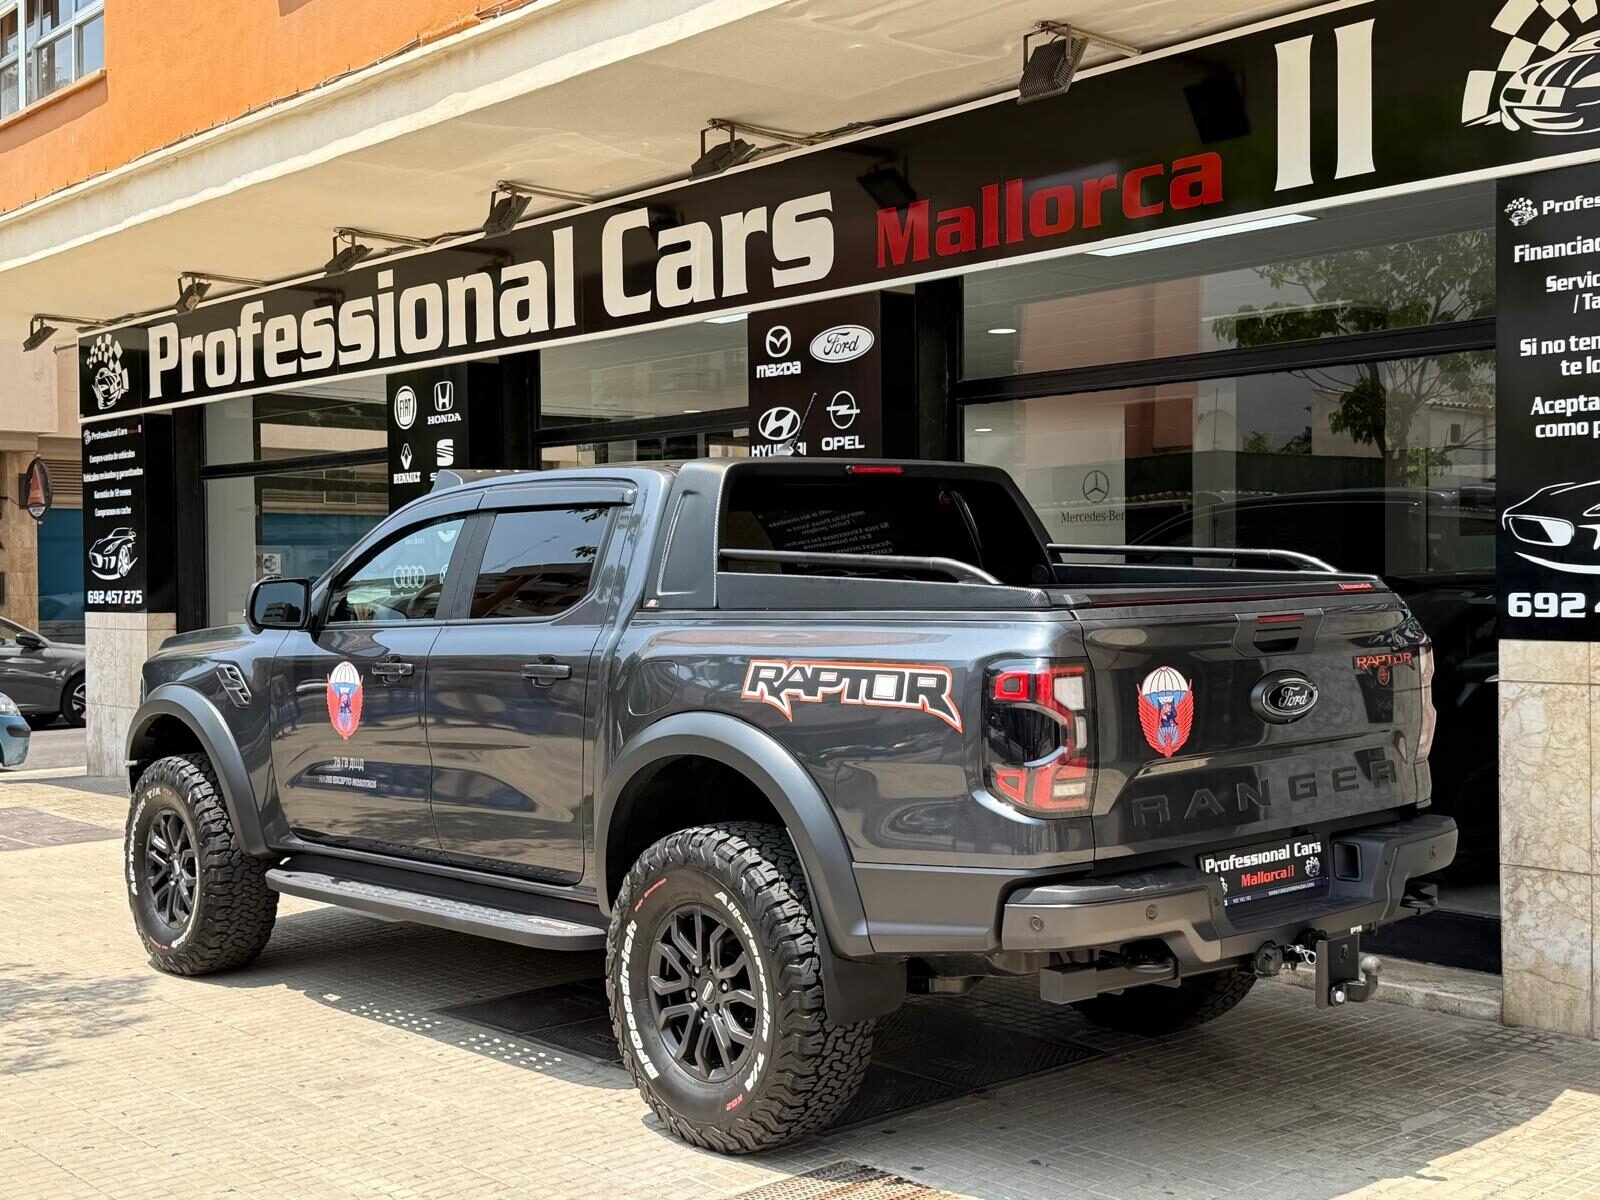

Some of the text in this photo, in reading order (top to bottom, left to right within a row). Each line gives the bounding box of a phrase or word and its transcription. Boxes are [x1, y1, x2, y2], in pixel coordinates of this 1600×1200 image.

[147, 18, 1377, 399] Professional Cars Mallorca II
[823, 331, 860, 356] Ford
[1520, 338, 1537, 357] Si
[1541, 340, 1566, 355] no
[756, 360, 801, 379] mazda
[1560, 359, 1582, 376] te
[400, 398, 411, 418] FIAT
[1530, 394, 1600, 417] Acepta
[427, 412, 462, 425] HONDA
[1535, 422, 1589, 438] como
[821, 435, 865, 451] OPEL
[393, 471, 421, 484] RENAULT
[87, 590, 142, 604] 692 457 275
[1507, 592, 1586, 618] 692
[1356, 652, 1413, 671] RAPTOR
[742, 660, 963, 733] RAPTOR
[1279, 686, 1308, 708] Ford
[1131, 760, 1397, 825] RANGER
[1205, 841, 1322, 873] Professional Cars
[1241, 869, 1287, 887] Mallorca
[621, 919, 659, 1080] BFGoodrich
